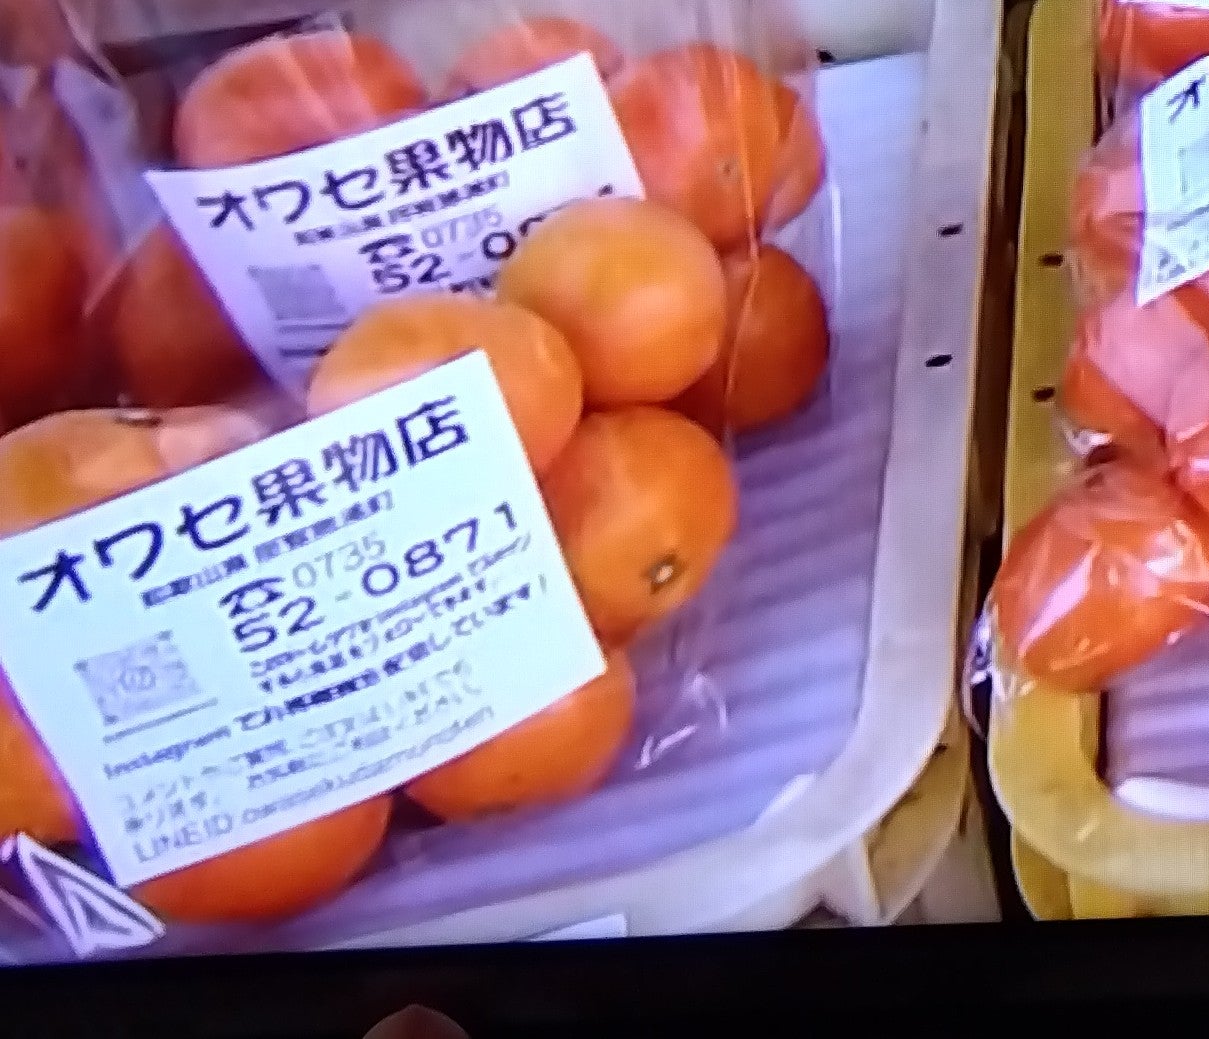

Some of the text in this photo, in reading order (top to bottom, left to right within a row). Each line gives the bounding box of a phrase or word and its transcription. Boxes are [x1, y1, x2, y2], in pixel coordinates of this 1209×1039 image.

[195, 91, 578, 231] オワセ果物店
[17, 394, 471, 612] オワセ果物店
[233, 501, 517, 653] 52-0871
